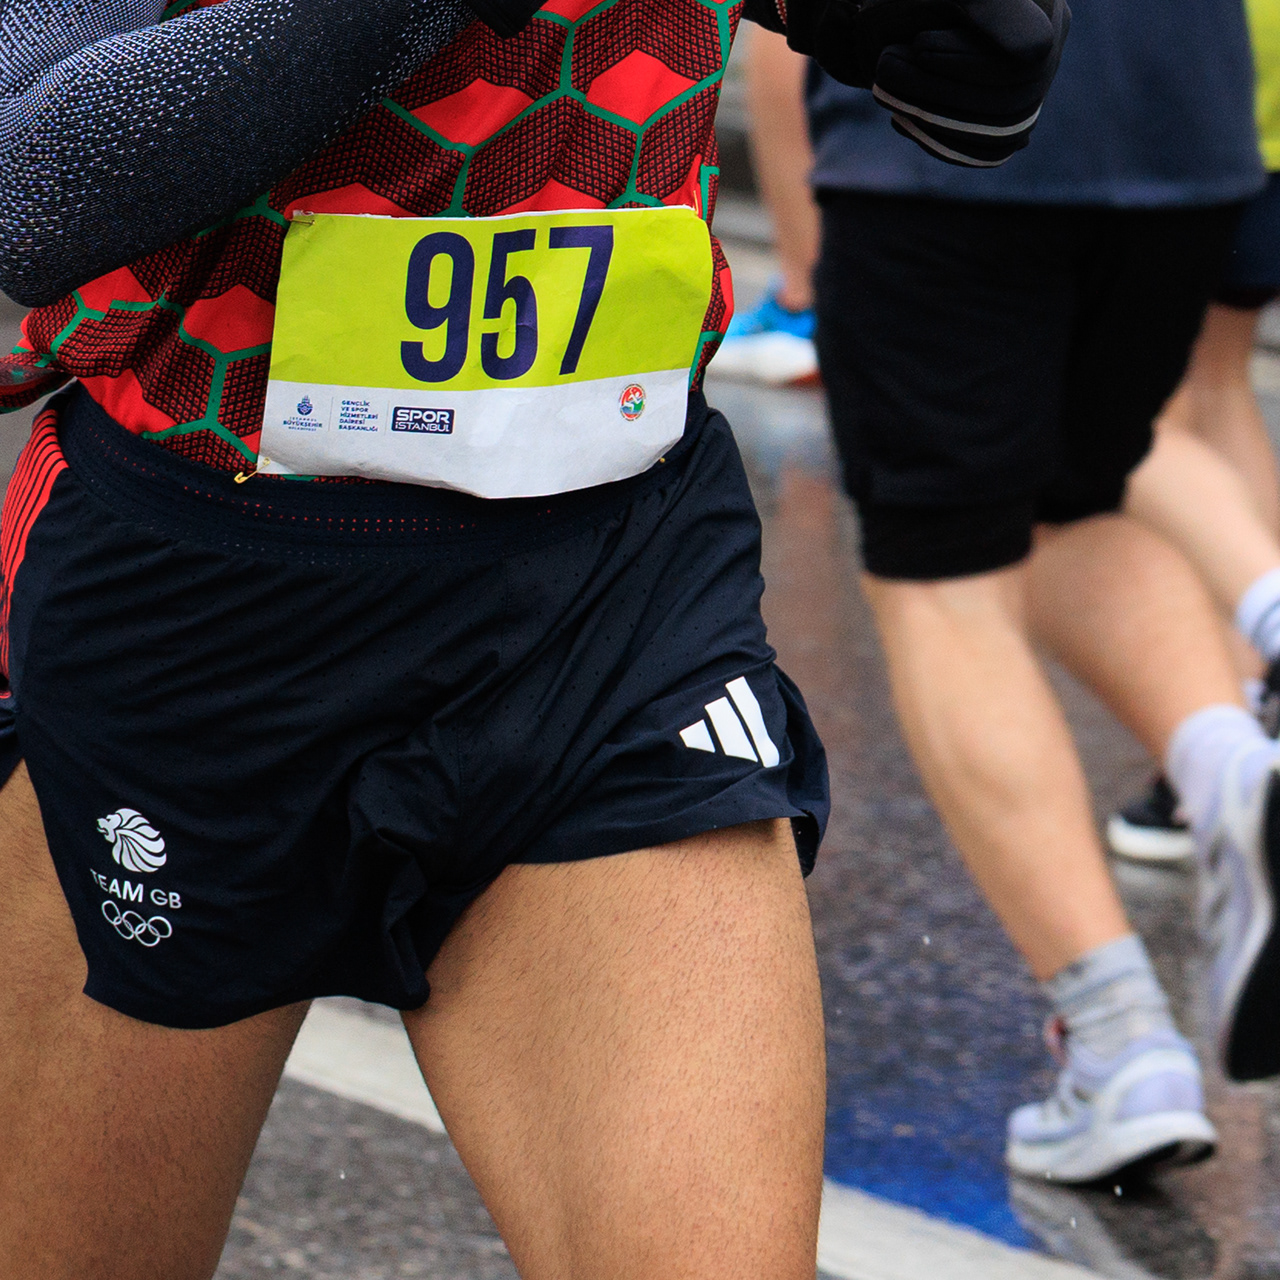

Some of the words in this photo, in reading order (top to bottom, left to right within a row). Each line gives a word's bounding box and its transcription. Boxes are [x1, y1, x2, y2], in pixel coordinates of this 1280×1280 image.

[400, 225, 614, 382] 957
[396, 409, 450, 424] SPOR
[90, 868, 144, 903] TEAM
[150, 889, 182, 909] GB
